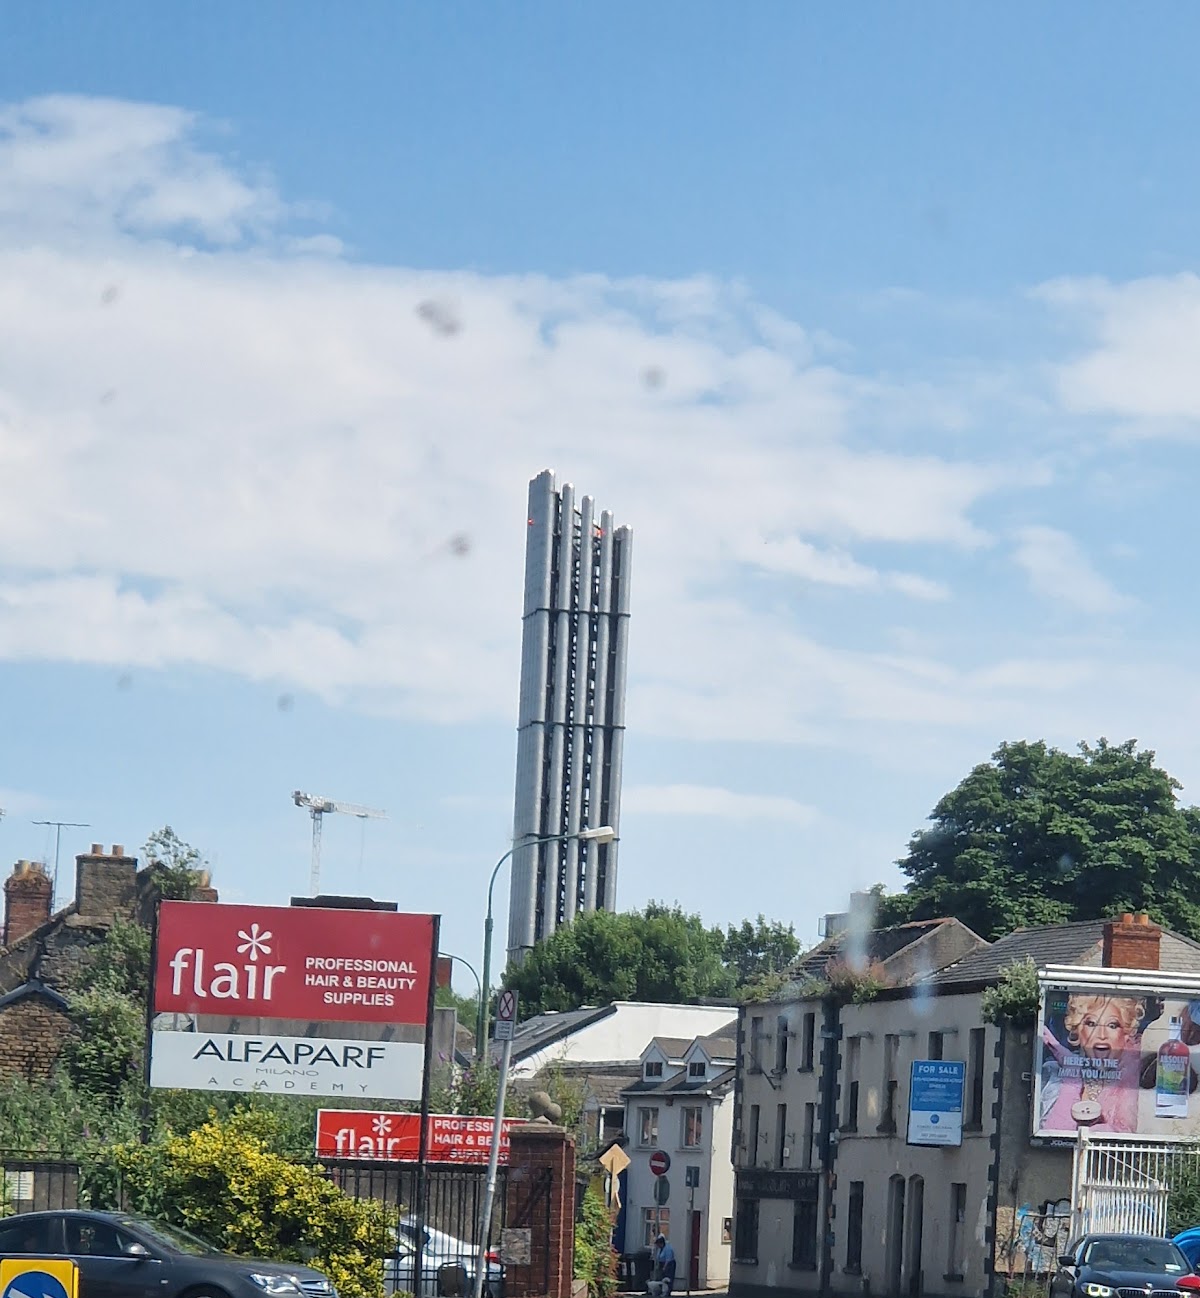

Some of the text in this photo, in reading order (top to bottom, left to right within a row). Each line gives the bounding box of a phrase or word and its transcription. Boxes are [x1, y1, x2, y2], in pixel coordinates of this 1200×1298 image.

[169, 923, 287, 1000] flair
[305, 957, 417, 974] PROFESSIONAL
[305, 974, 416, 990] HAIR & BEAUTY
[323, 991, 395, 1006] SUPPLIES
[192, 1039, 386, 1069] ALFAPARF
[1160, 1054, 1188, 1065] ABSOLUT
[1063, 1056, 1119, 1068] HERE'S TO THE
[255, 1067, 320, 1077] MILANO
[918, 1065, 958, 1075] FOR SALE
[1081, 1068, 1098, 1079] YOU
[207, 1076, 369, 1093] ACADEMY
[434, 1119, 511, 1133] PROFESSIN
[334, 1115, 401, 1158] flair
[434, 1133, 464, 1145] HAIR
[465, 1134, 475, 1145] &
